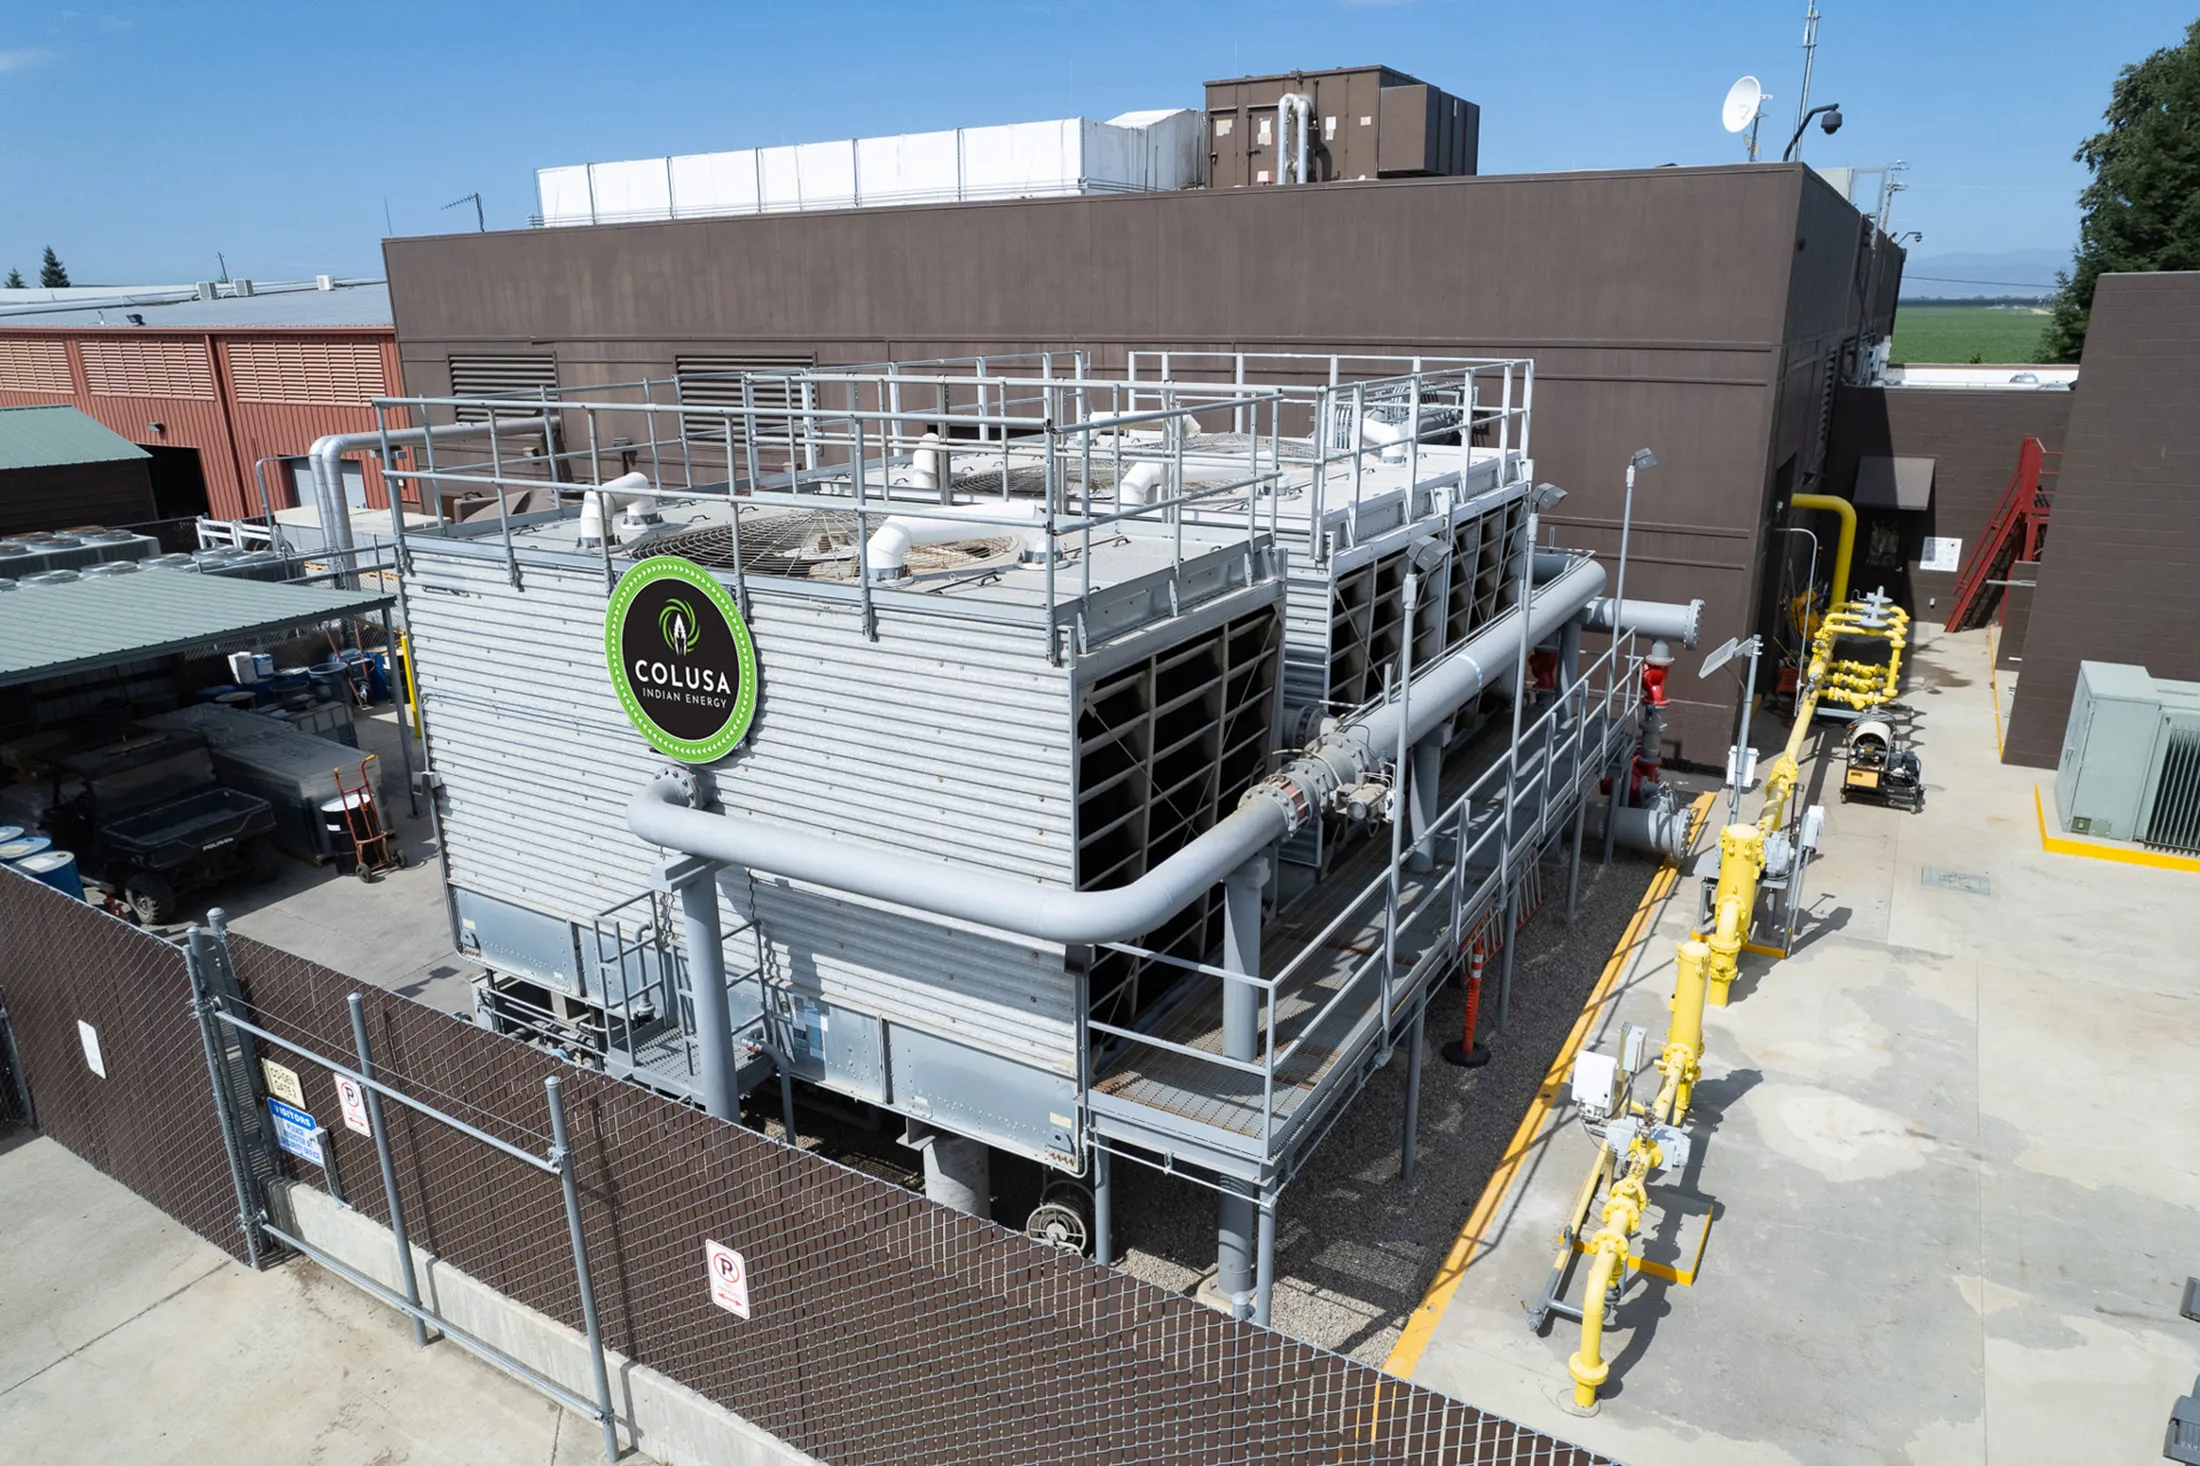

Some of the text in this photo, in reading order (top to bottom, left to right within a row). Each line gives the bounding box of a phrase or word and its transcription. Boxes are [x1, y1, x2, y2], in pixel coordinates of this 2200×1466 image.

[635, 660, 731, 694] COLUSA
[642, 687, 727, 708] INDIAN ENERGY
[273, 1104, 312, 1128] VISITORS
